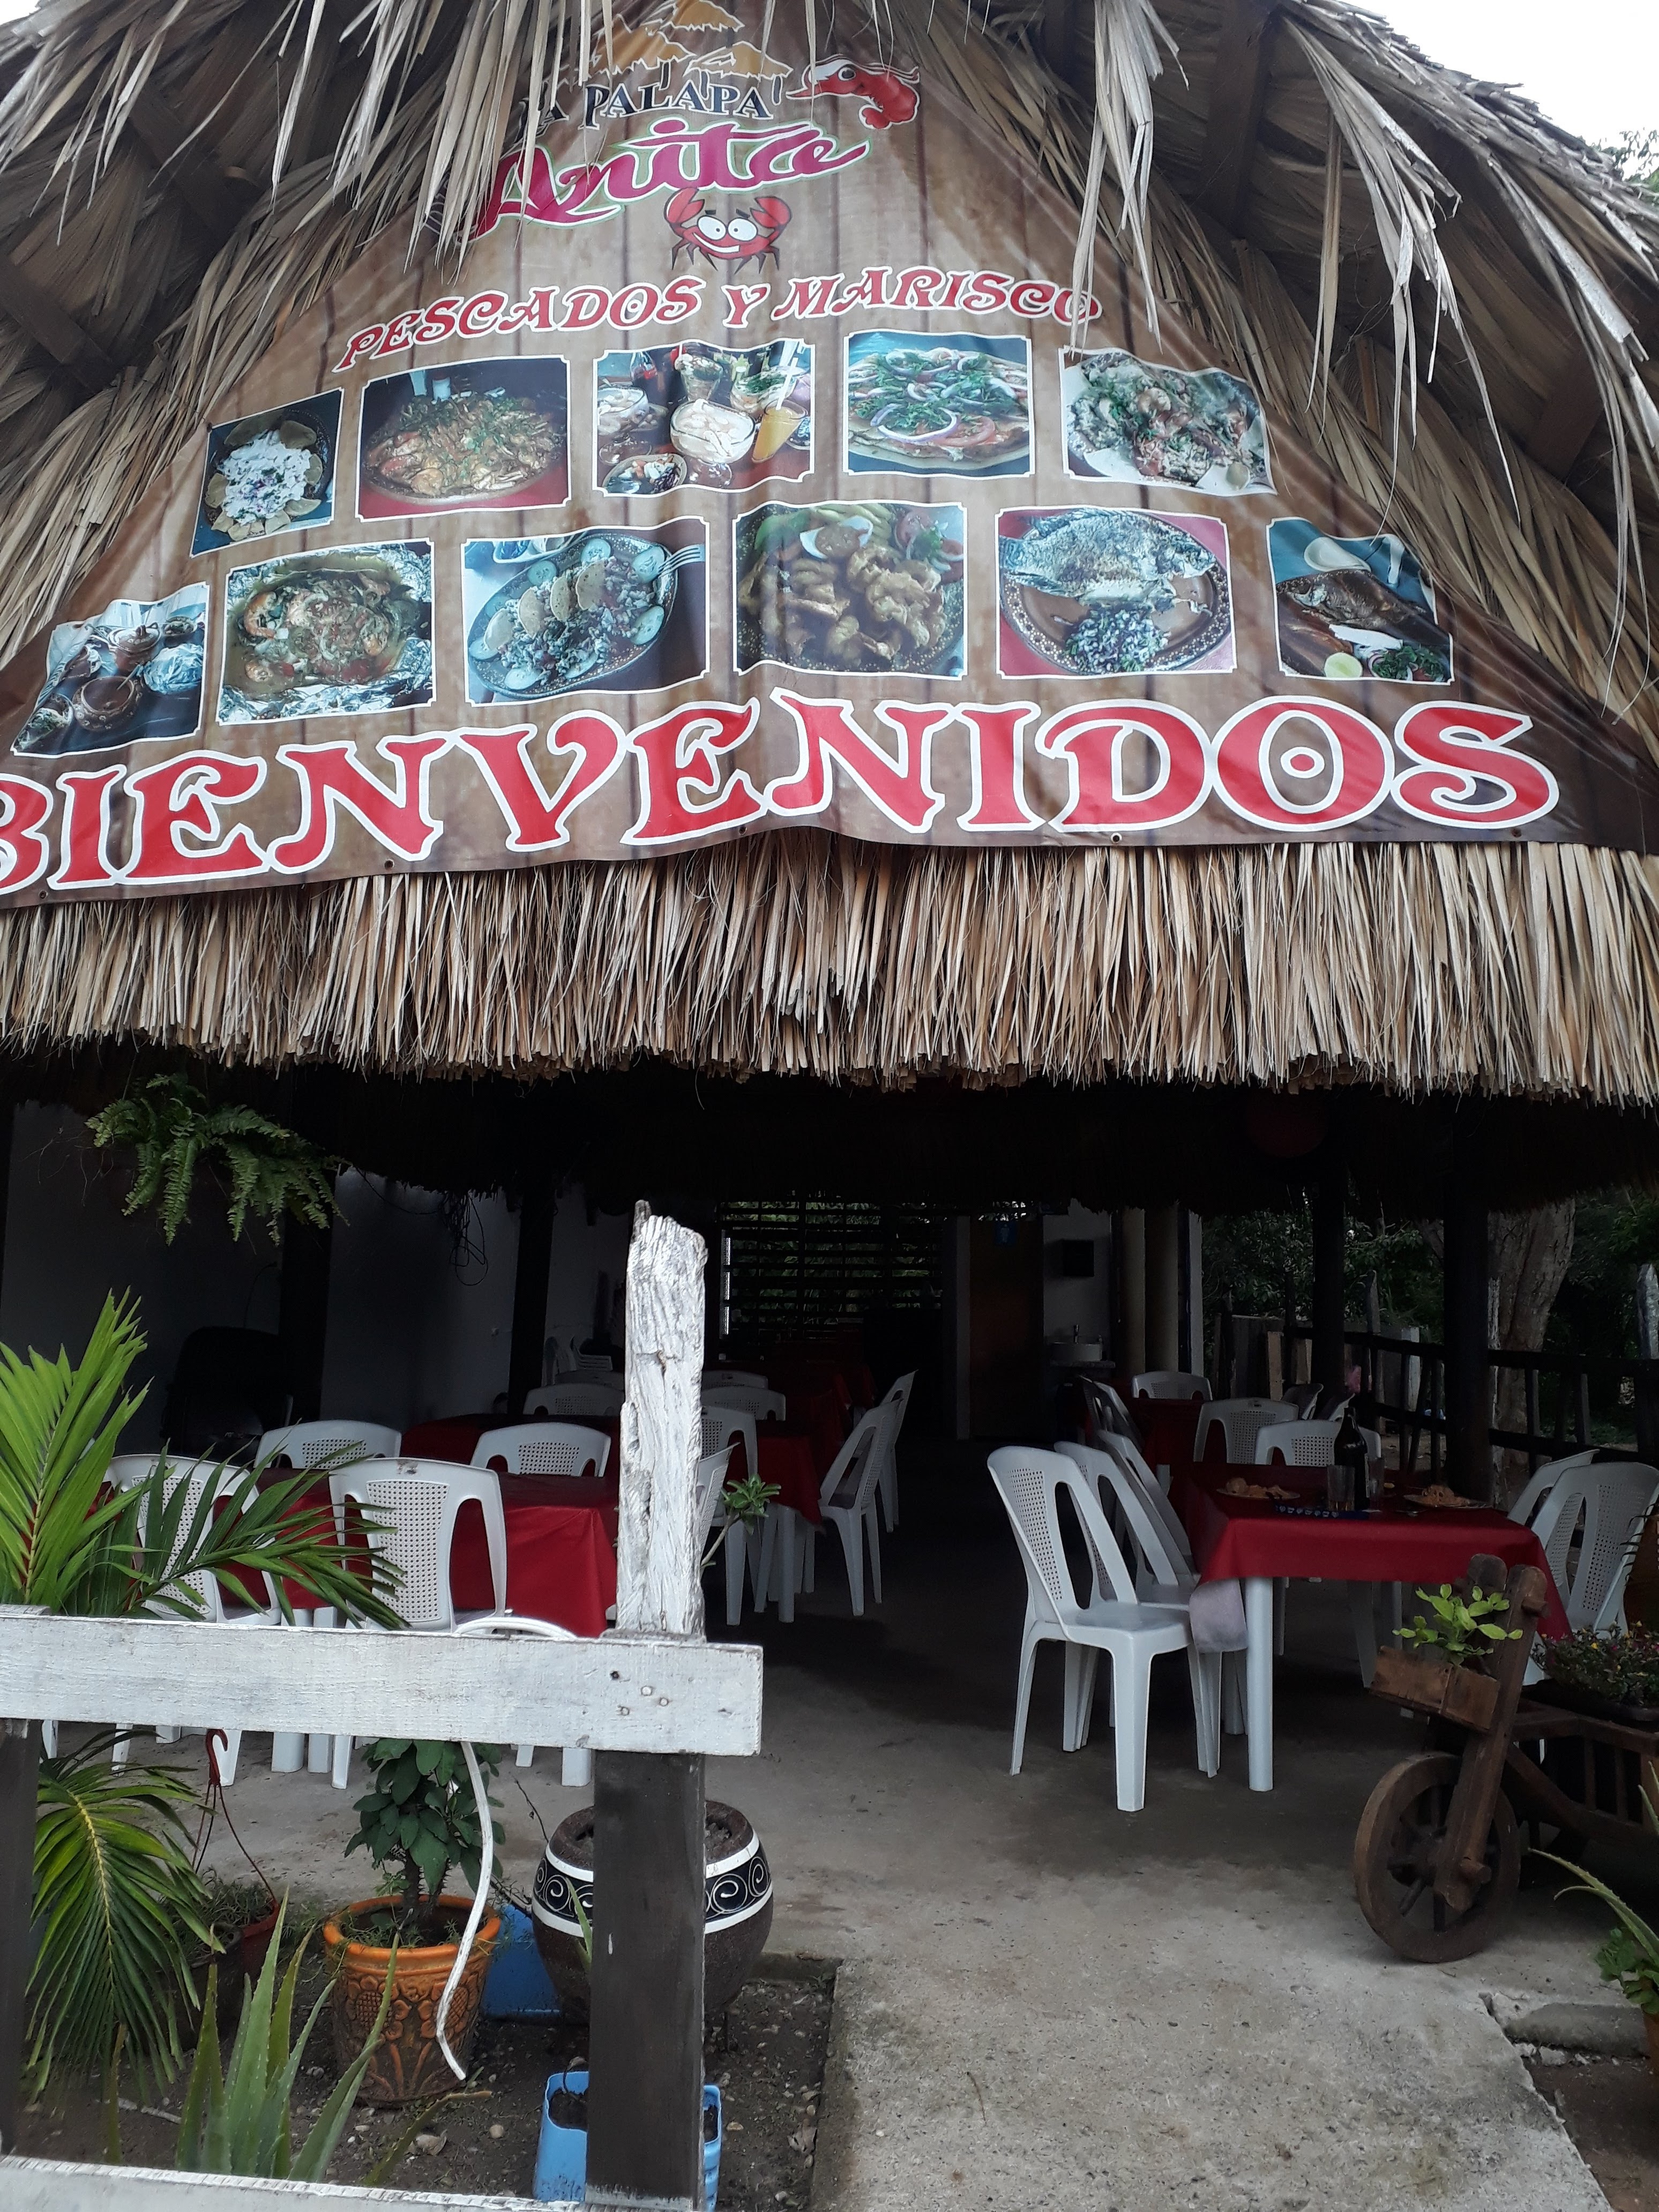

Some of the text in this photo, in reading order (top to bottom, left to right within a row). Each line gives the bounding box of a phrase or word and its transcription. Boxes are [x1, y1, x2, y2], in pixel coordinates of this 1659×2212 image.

[577, 79, 775, 130] PALAPA
[454, 117, 871, 243] Anita
[331, 265, 1103, 373] PESCADOS Y MARISCO
[0, 686, 1560, 895] BIENVENIDOS
